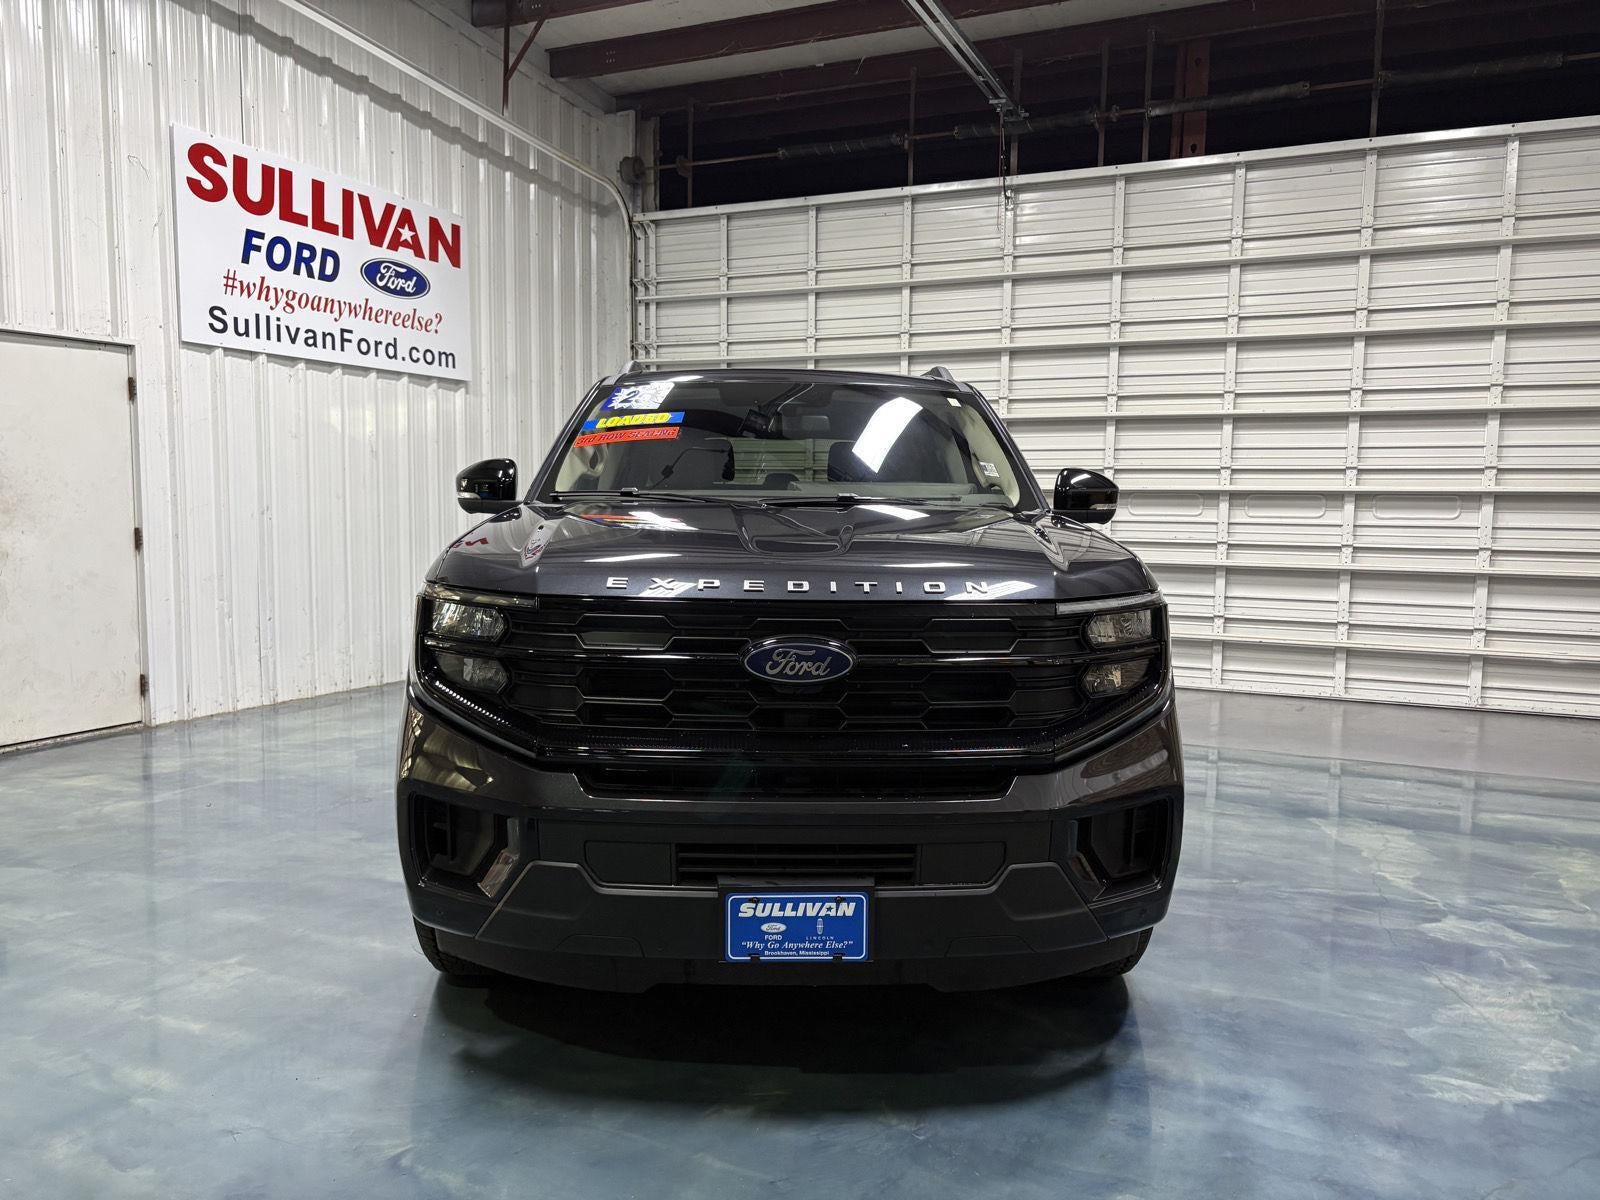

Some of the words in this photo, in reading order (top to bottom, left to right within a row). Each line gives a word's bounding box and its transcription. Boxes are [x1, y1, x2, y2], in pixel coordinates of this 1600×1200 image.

[186, 142, 461, 269] SULLIVAN
[241, 228, 341, 283] FORD
[376, 262, 417, 293] Ford
[223, 268, 443, 334] #whygoanywhereelse?
[208, 305, 456, 369] SullivanFord.com
[606, 576, 989, 595] EXPEDITION
[765, 647, 832, 678] Ford
[738, 902, 856, 918] SULLIVAN
[767, 941, 780, 949] Go
[782, 941, 823, 950] Anywhere
